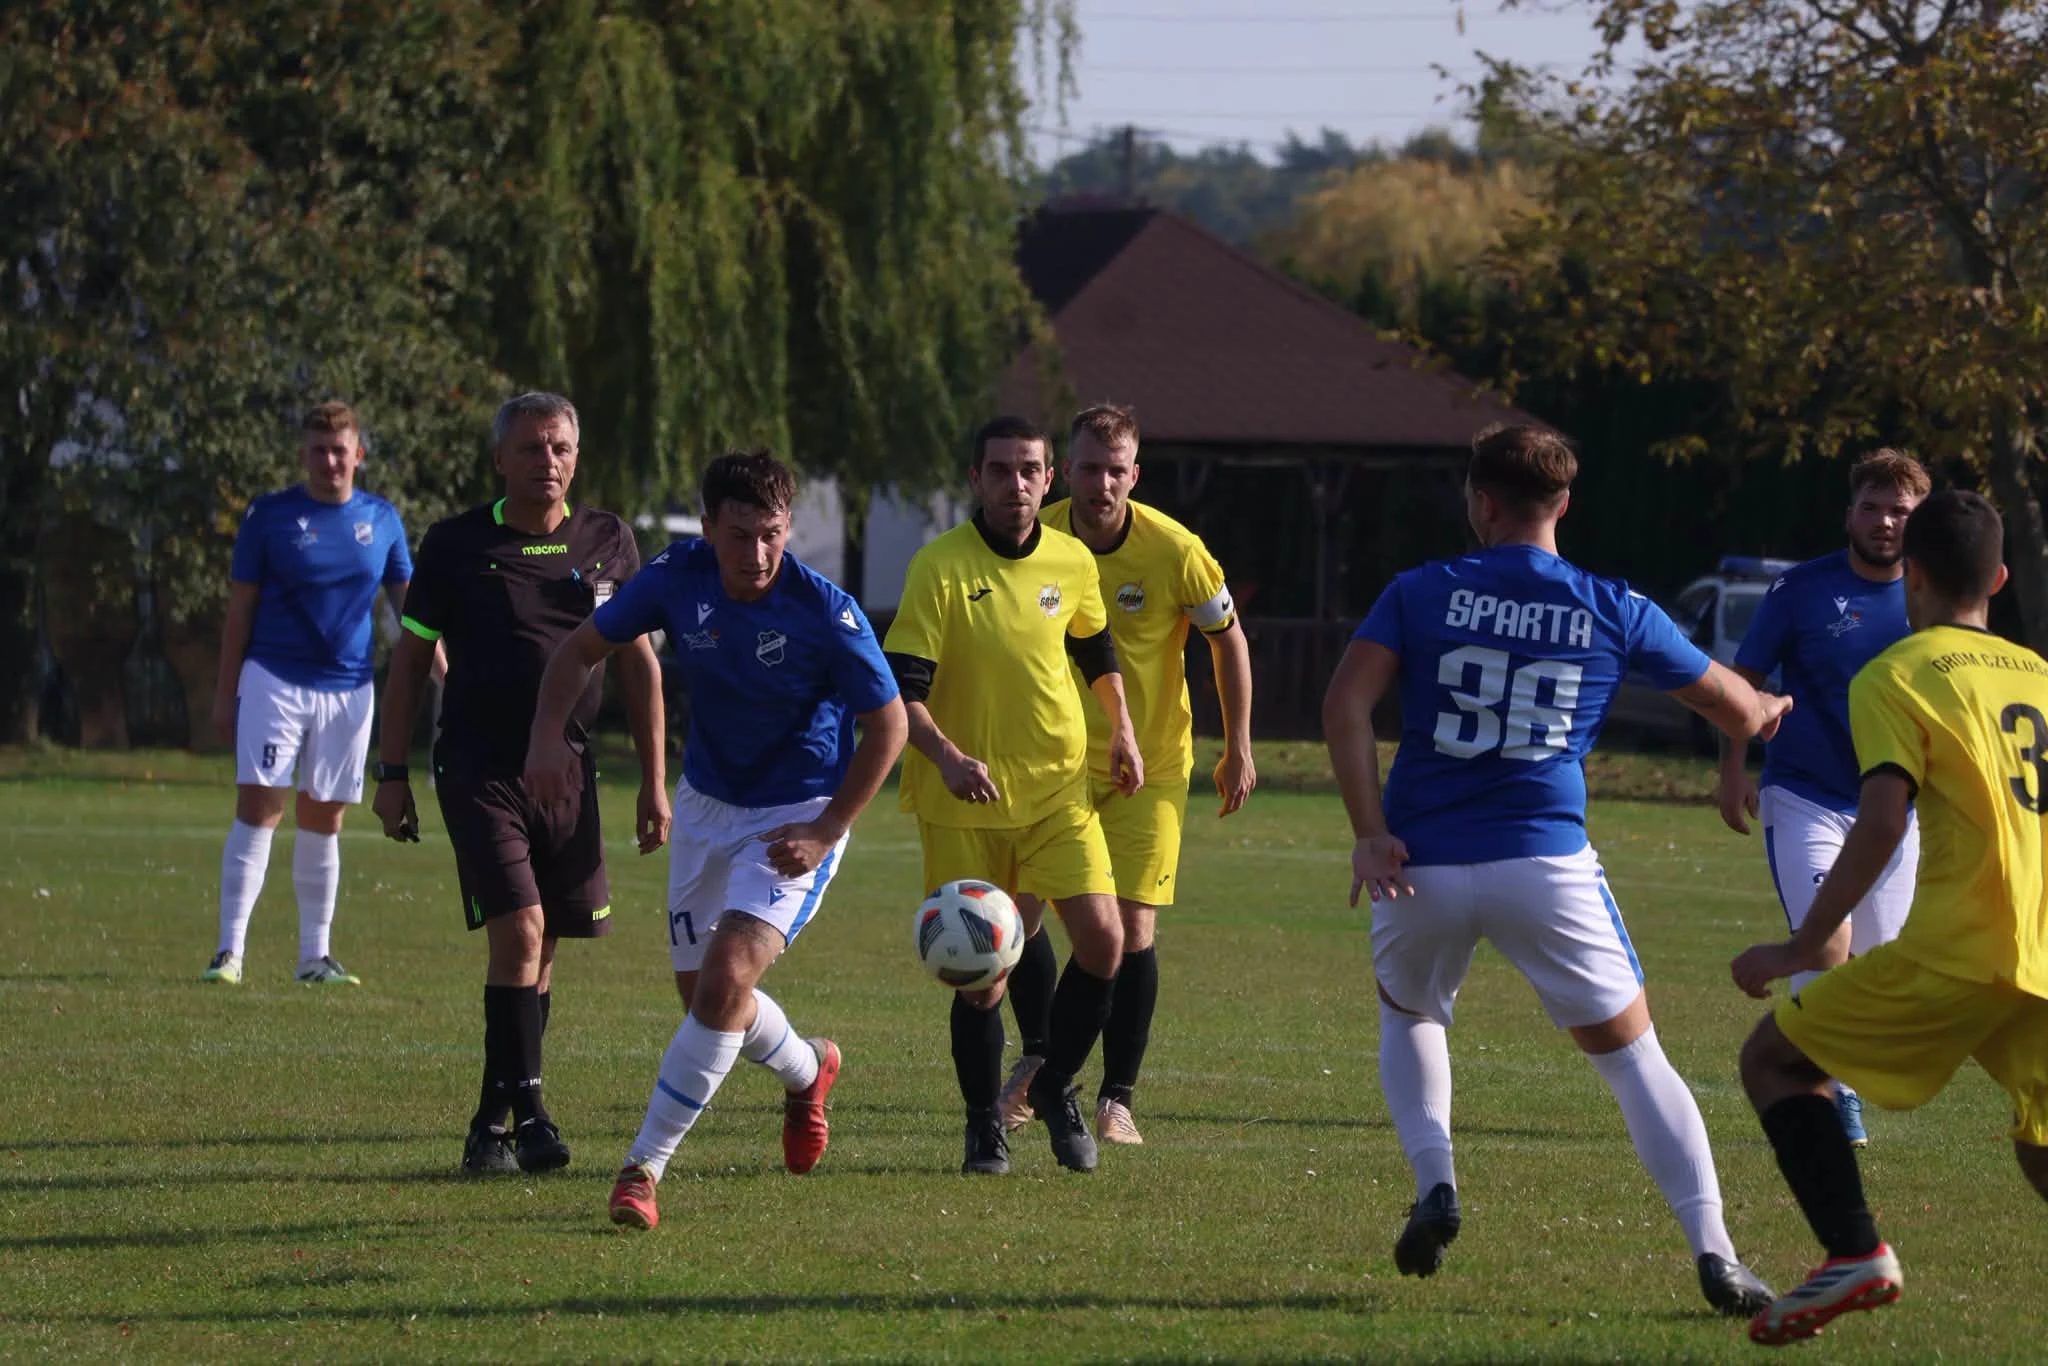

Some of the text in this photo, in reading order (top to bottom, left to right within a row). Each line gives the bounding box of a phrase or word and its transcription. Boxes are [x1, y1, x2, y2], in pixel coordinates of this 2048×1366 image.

[522, 544, 568, 556] macron
[1446, 588, 1594, 649] SPARTA
[1931, 651, 1980, 673] GROM
